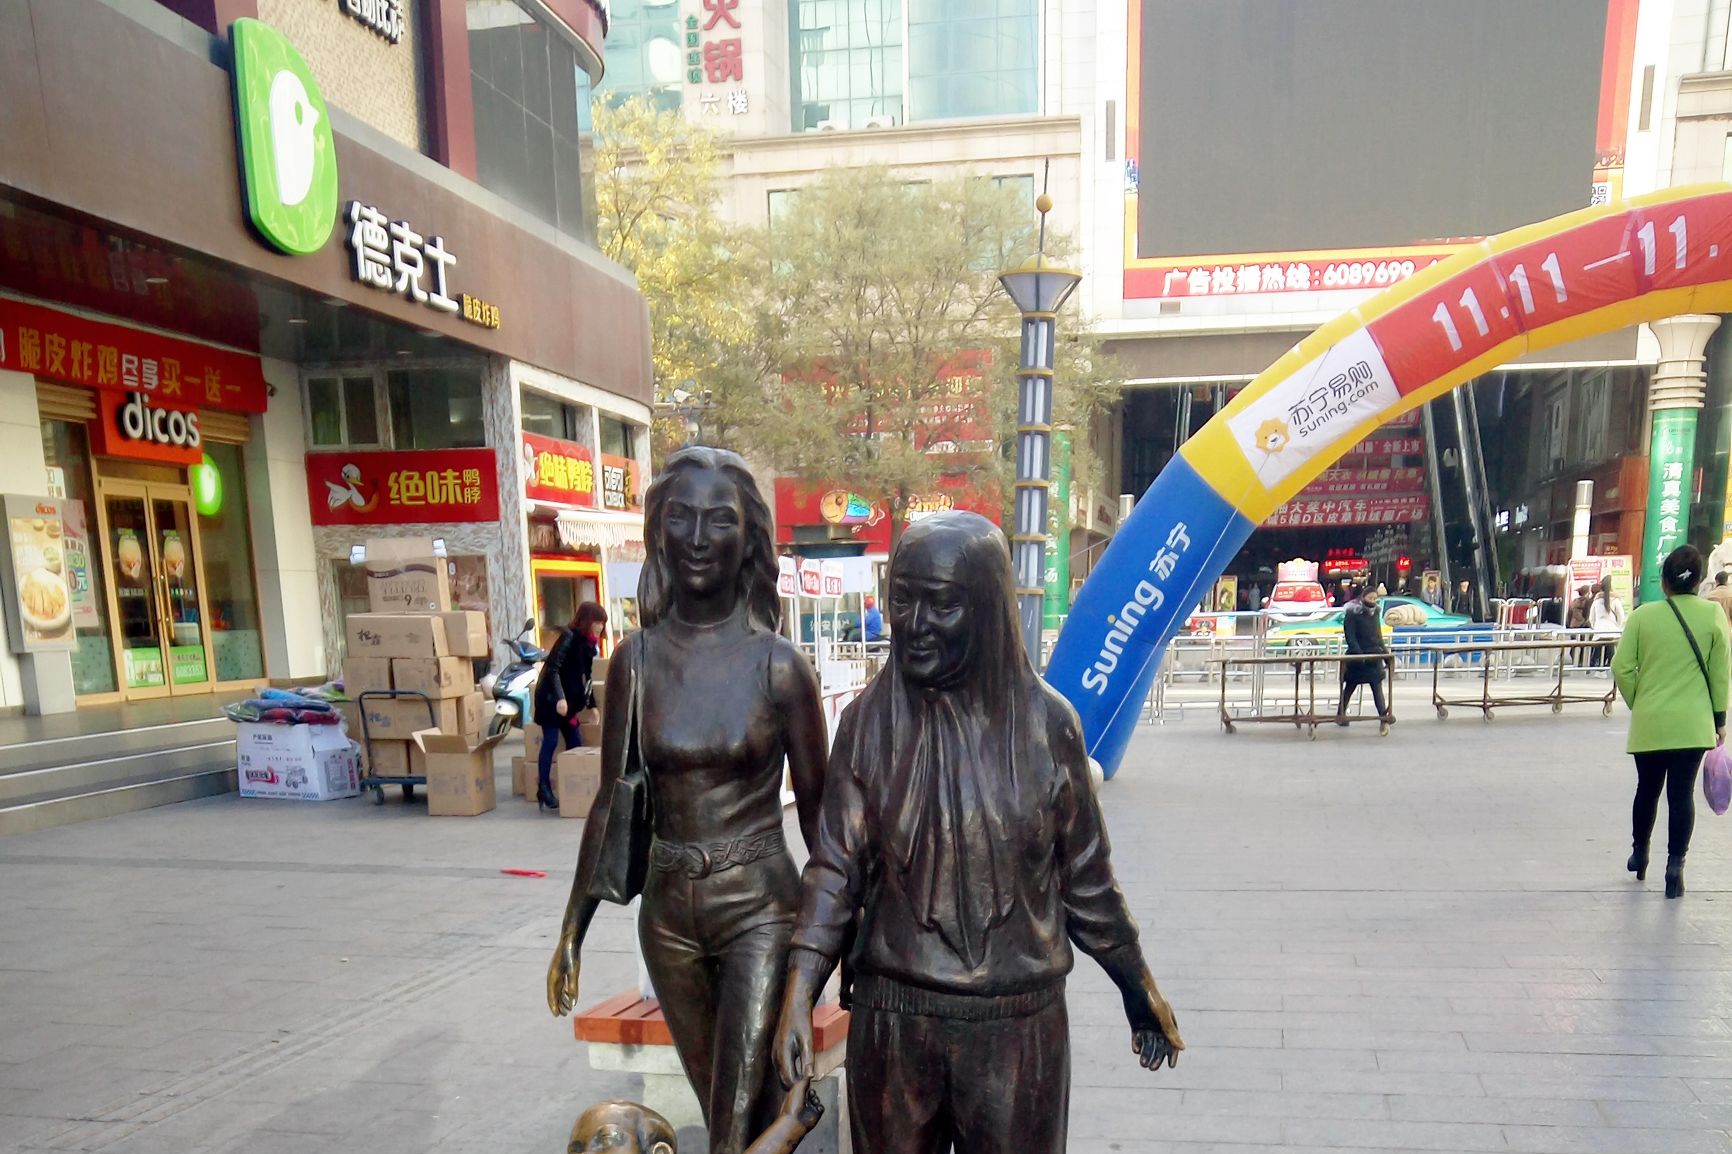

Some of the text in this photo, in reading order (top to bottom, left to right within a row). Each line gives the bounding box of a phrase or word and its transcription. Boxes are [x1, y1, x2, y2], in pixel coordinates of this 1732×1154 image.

[700, 89, 748, 115] 六楼
[350, 200, 459, 312] 德克士
[123, 391, 200, 448] dicos
[1288, 361, 1373, 425] 苏宁易购
[1299, 381, 1379, 437] suning.com
[1082, 522, 1190, 695] Suning 苏宁
